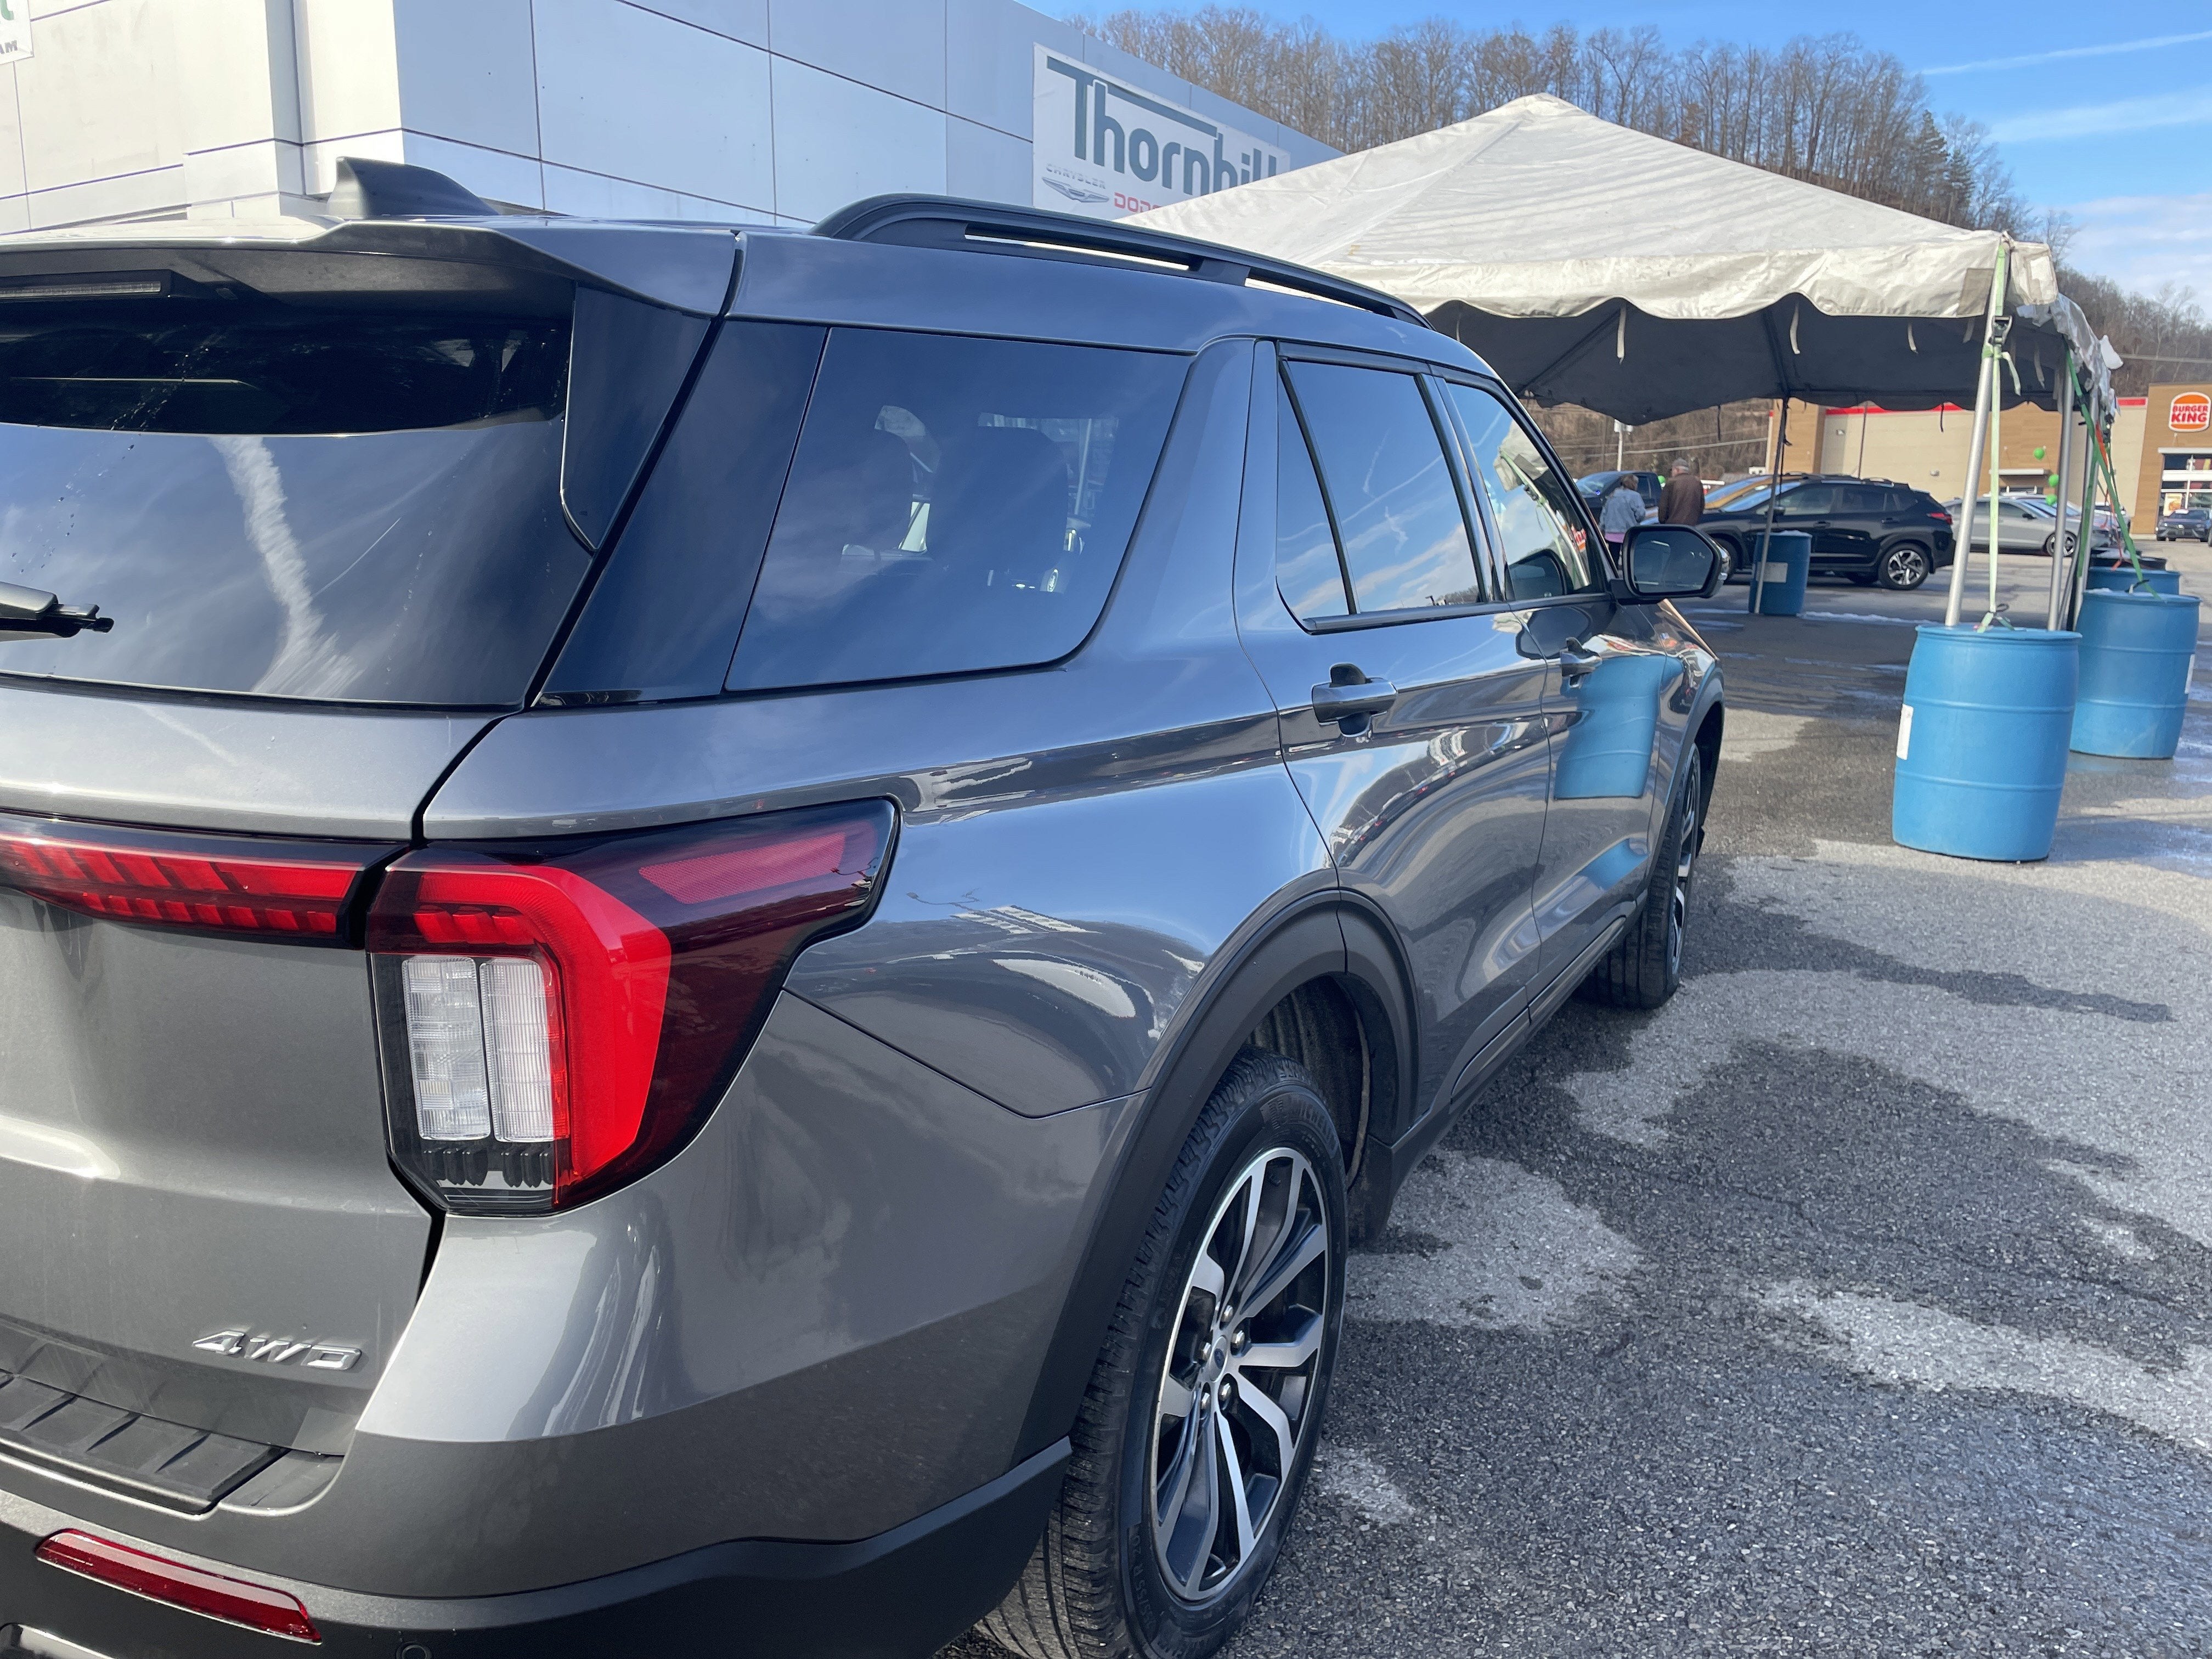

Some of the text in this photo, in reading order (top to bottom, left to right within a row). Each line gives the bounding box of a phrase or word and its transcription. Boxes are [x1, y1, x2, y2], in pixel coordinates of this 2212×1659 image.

[1046, 163, 1106, 190] CHRYSLER
[2171, 413, 2207, 422] KING
[192, 1330, 363, 1371] 4WD
